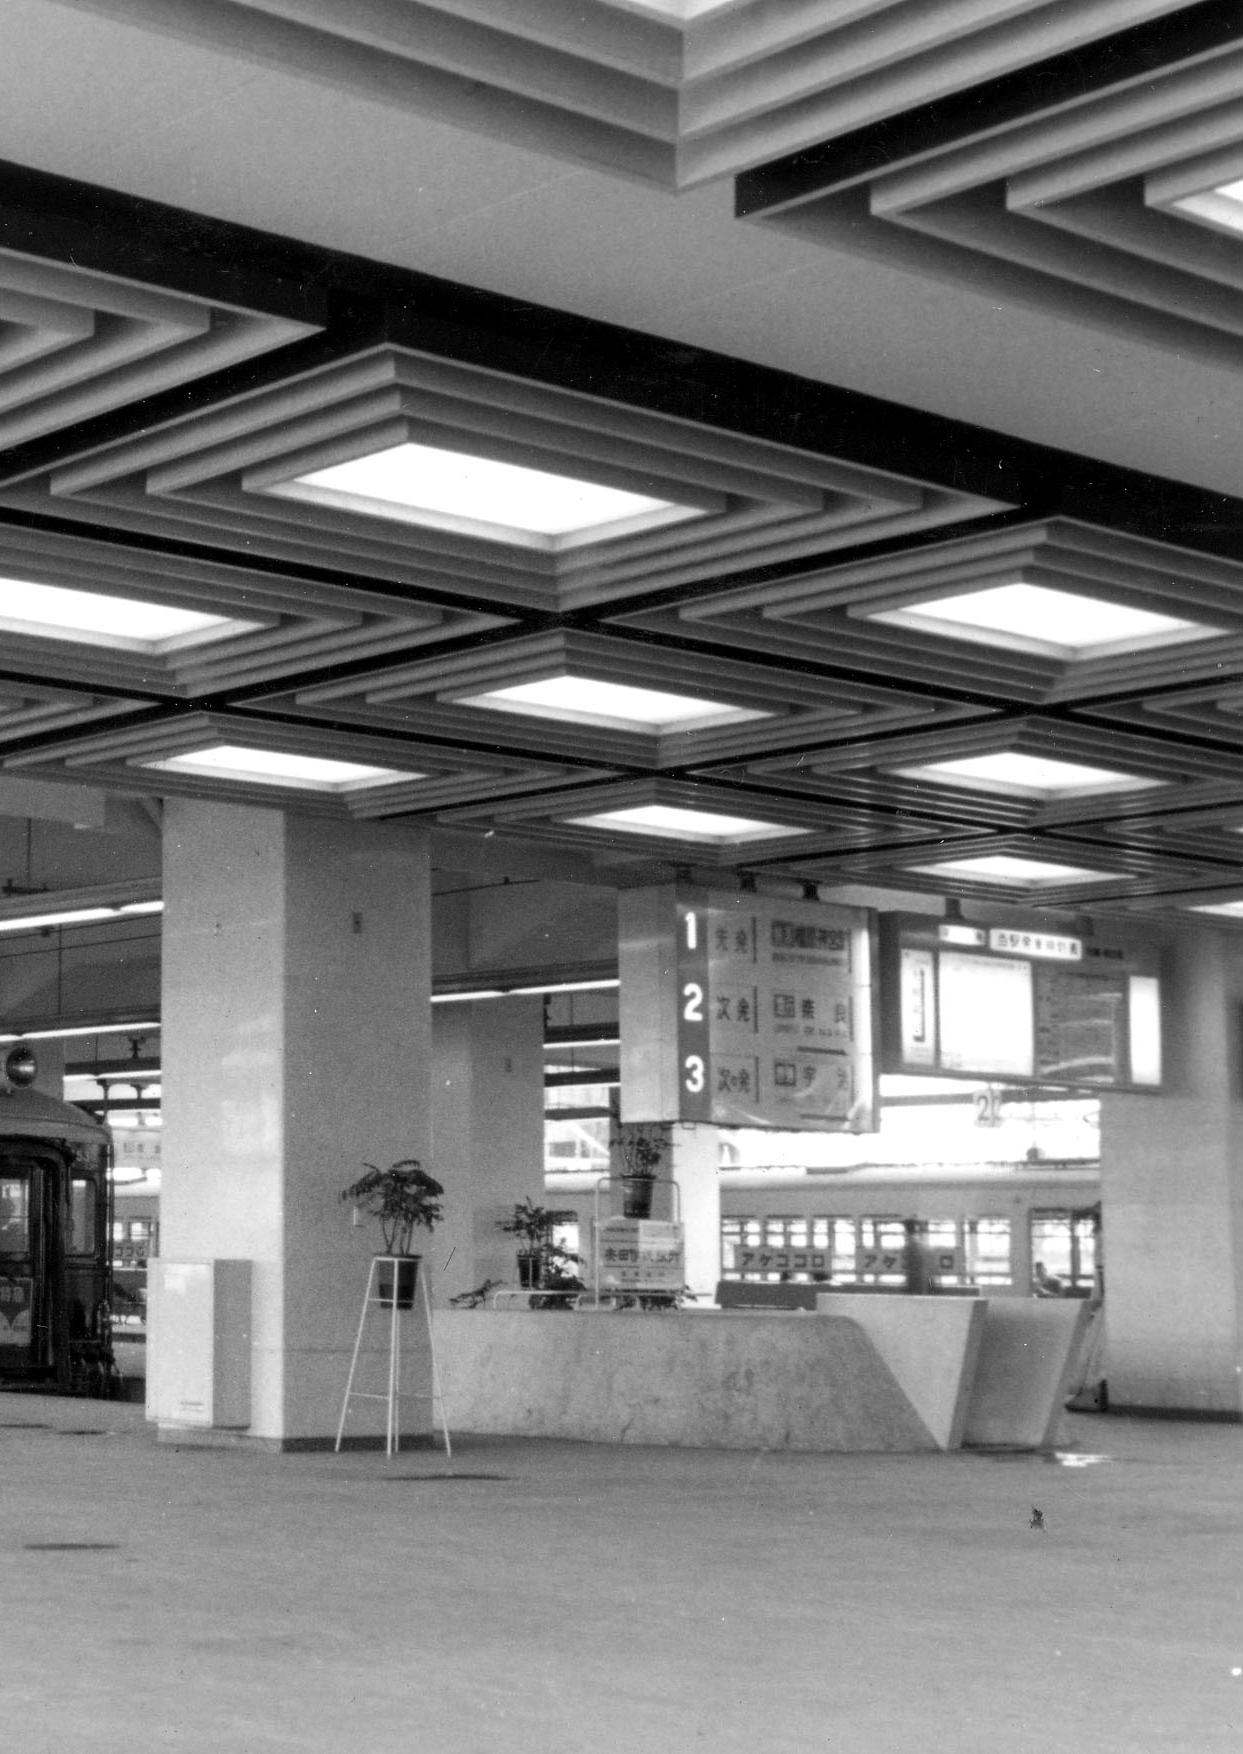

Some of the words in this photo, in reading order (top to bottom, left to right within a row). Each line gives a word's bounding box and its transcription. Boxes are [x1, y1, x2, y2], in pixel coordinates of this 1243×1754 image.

[684, 912, 697, 949] 1
[683, 983, 703, 1021] 2
[716, 996, 750, 1023] 次発
[685, 1055, 704, 1093] 3
[741, 1252, 826, 1269] アケココロ
[865, 1254, 955, 1270] アケロ
